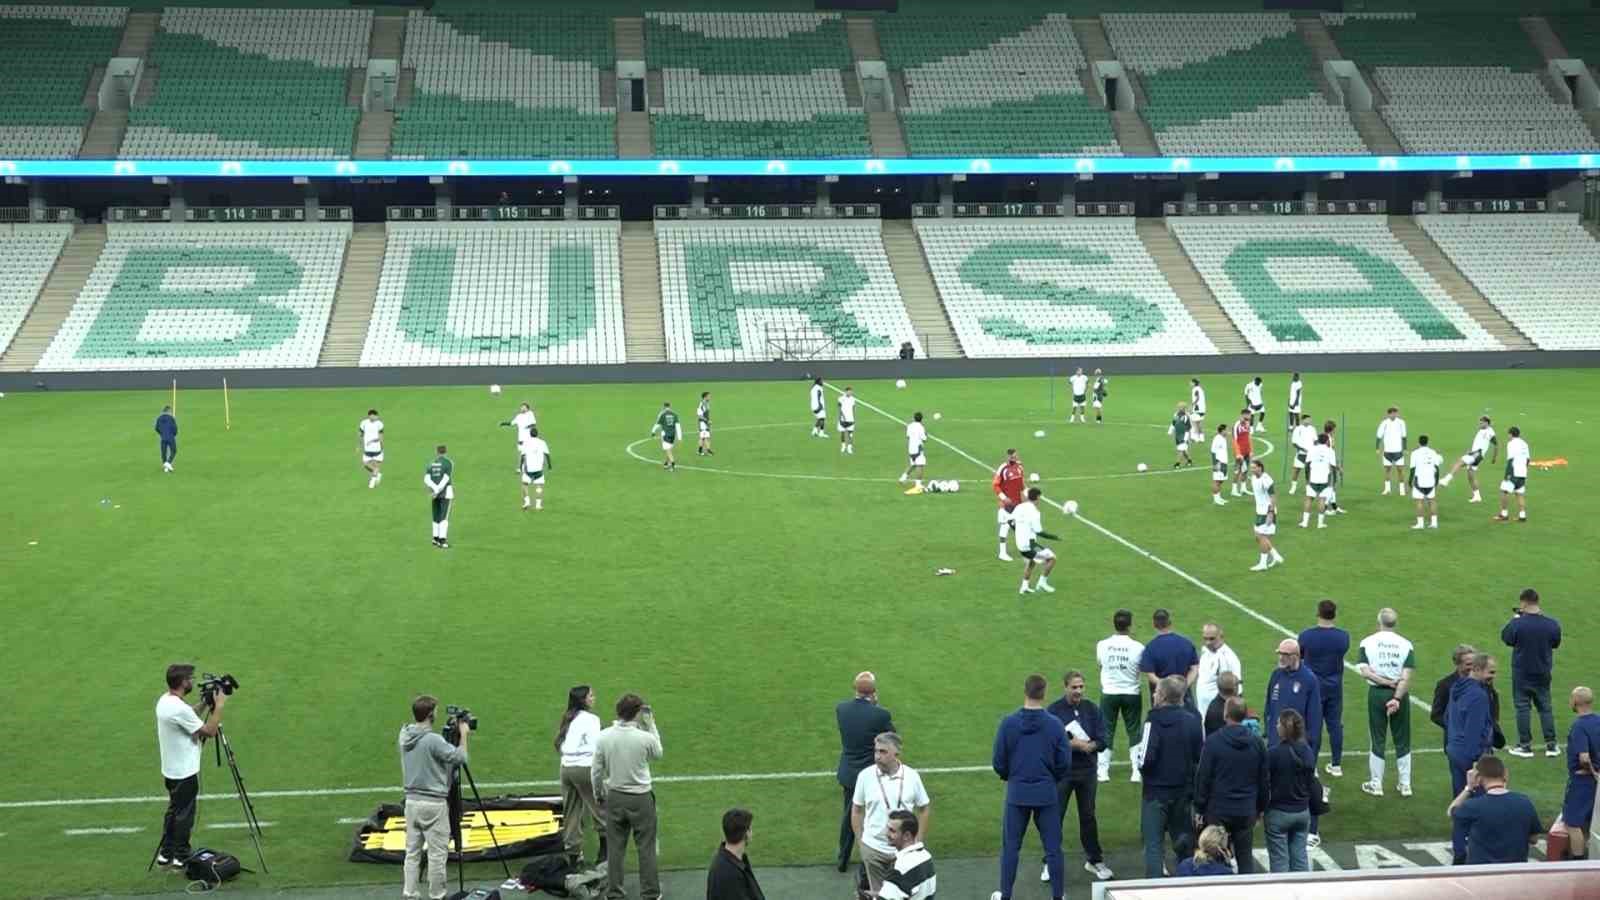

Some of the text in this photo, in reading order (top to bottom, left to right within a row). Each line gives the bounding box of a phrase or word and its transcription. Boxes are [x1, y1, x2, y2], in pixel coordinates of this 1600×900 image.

[746, 206, 766, 217] 116
[1003, 203, 1023, 215] 117
[1273, 201, 1291, 214] 118
[1491, 199, 1510, 212] 119
[224, 208, 245, 220] 114
[498, 206, 518, 218] 115
[72, 237, 1467, 359] BURSA
